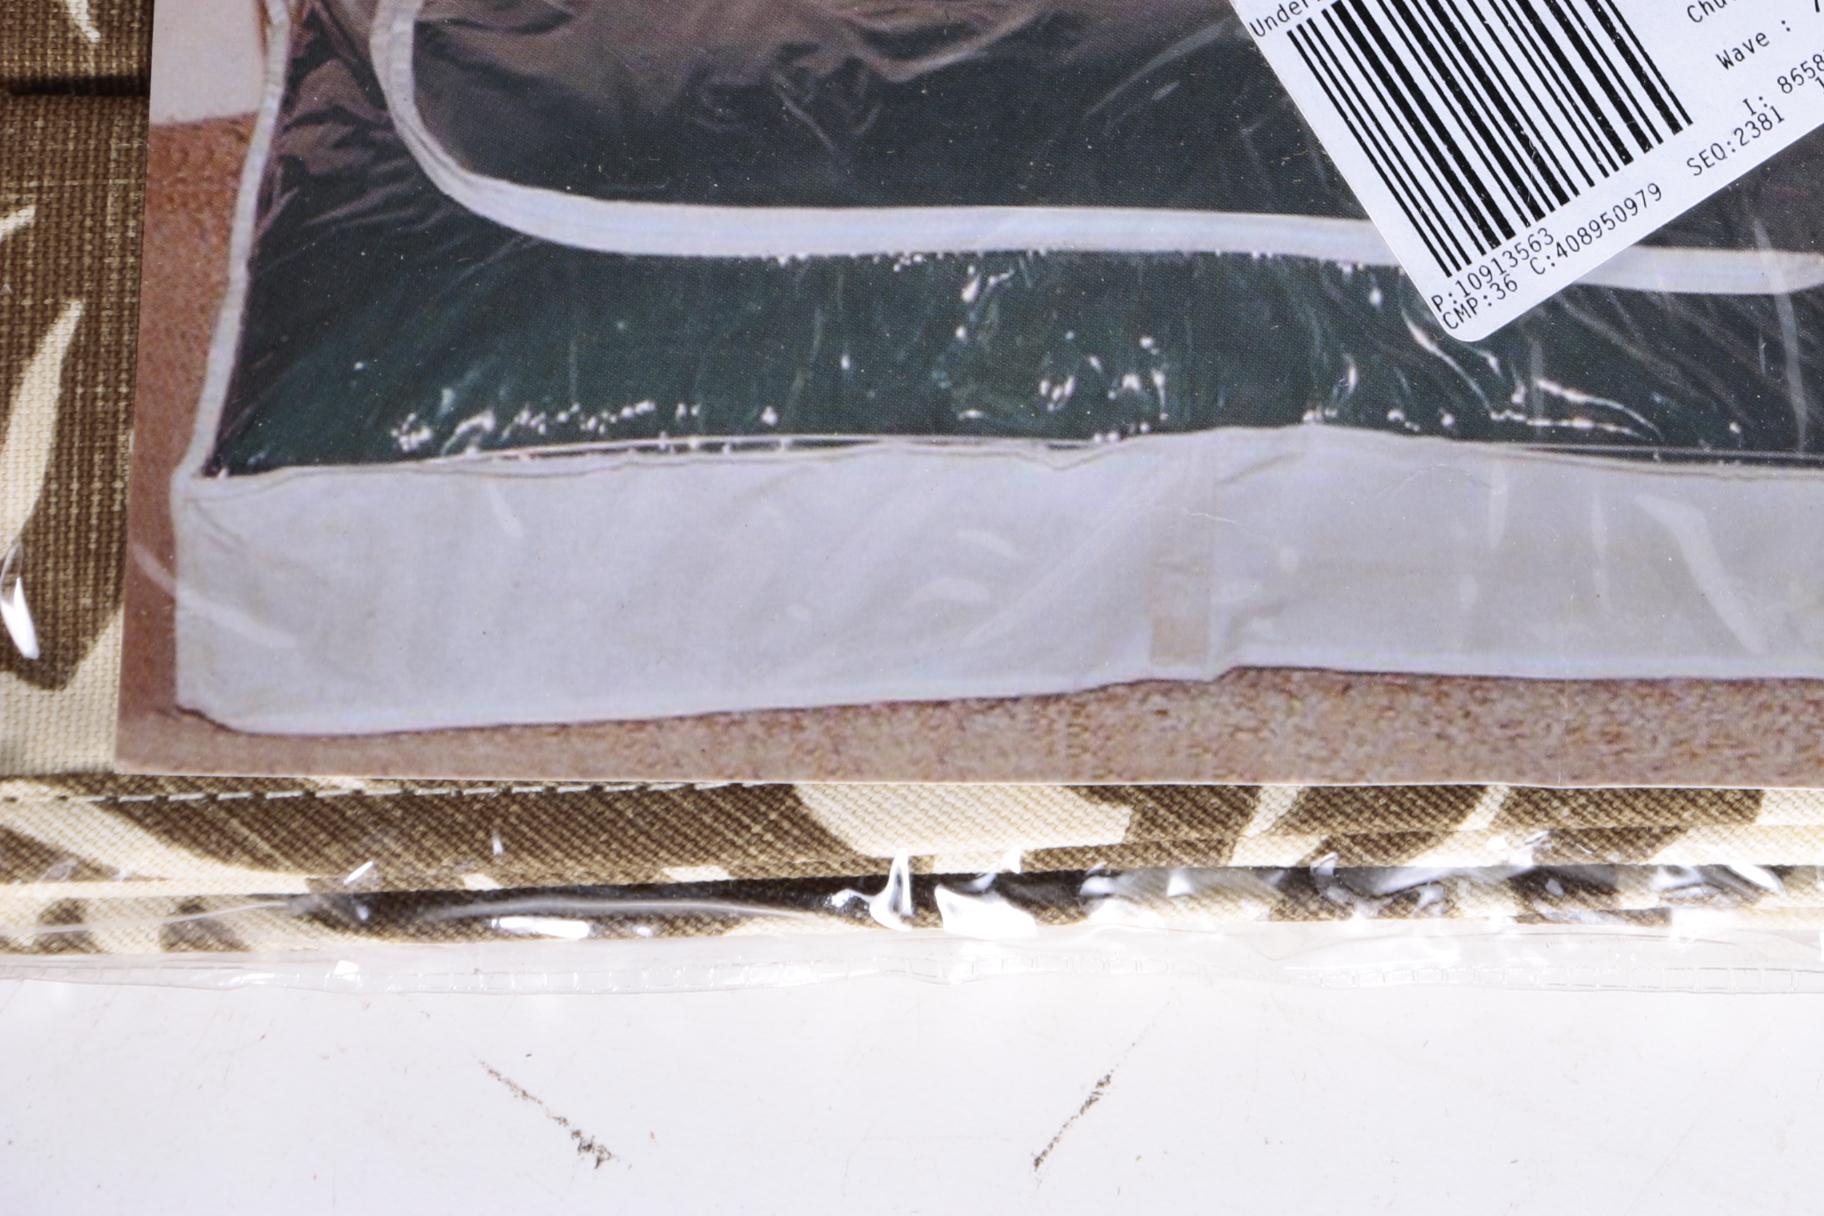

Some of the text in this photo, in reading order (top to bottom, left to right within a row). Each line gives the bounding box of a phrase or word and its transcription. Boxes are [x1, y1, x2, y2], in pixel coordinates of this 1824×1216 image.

[1716, 31, 1771, 71] Wave
[1743, 95, 1767, 116] I:
[1441, 279, 1518, 331] CMP:36
[1529, 182, 1664, 277] C:408950979
[1686, 106, 1786, 177] SEQ:2381
[1432, 227, 1555, 312] P:10913563
